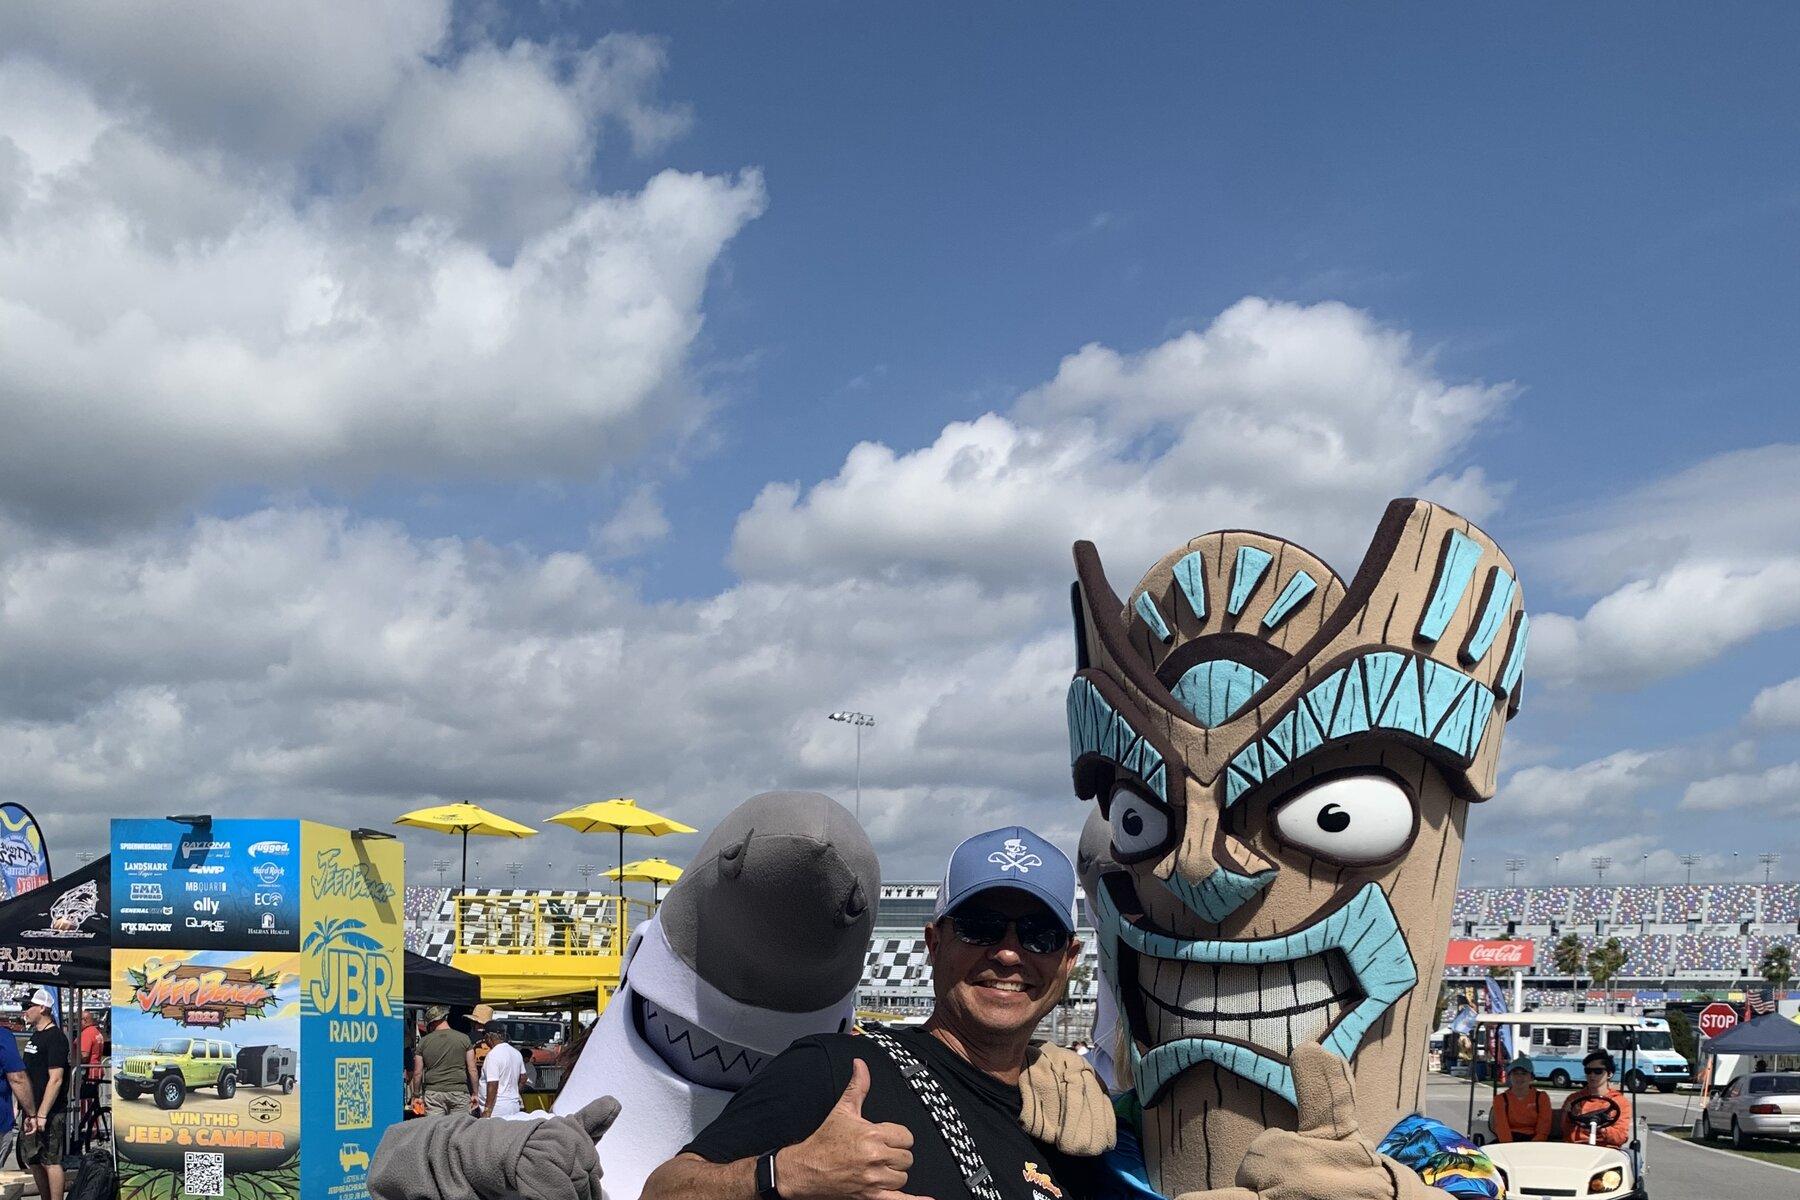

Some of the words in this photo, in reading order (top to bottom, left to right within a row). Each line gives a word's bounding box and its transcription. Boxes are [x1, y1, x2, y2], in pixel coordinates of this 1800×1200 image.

[253, 866, 269, 874] Hard
[269, 866, 285, 876] Rock
[885, 889, 925, 897] NTER
[193, 897, 221, 915] ally
[138, 924, 173, 932] FACTORY
[17, 946, 74, 963] BOTTOM
[309, 948, 393, 1017] JBR
[186, 1011, 220, 1023] 2022
[1702, 1013, 1735, 1030] STOP
[329, 1020, 379, 1043] RADIO
[168, 1112, 202, 1126] WIN
[203, 1113, 239, 1128] THIS
[124, 1126, 174, 1144] JEEP
[177, 1126, 193, 1146] &
[195, 1129, 286, 1149] CAMPER
